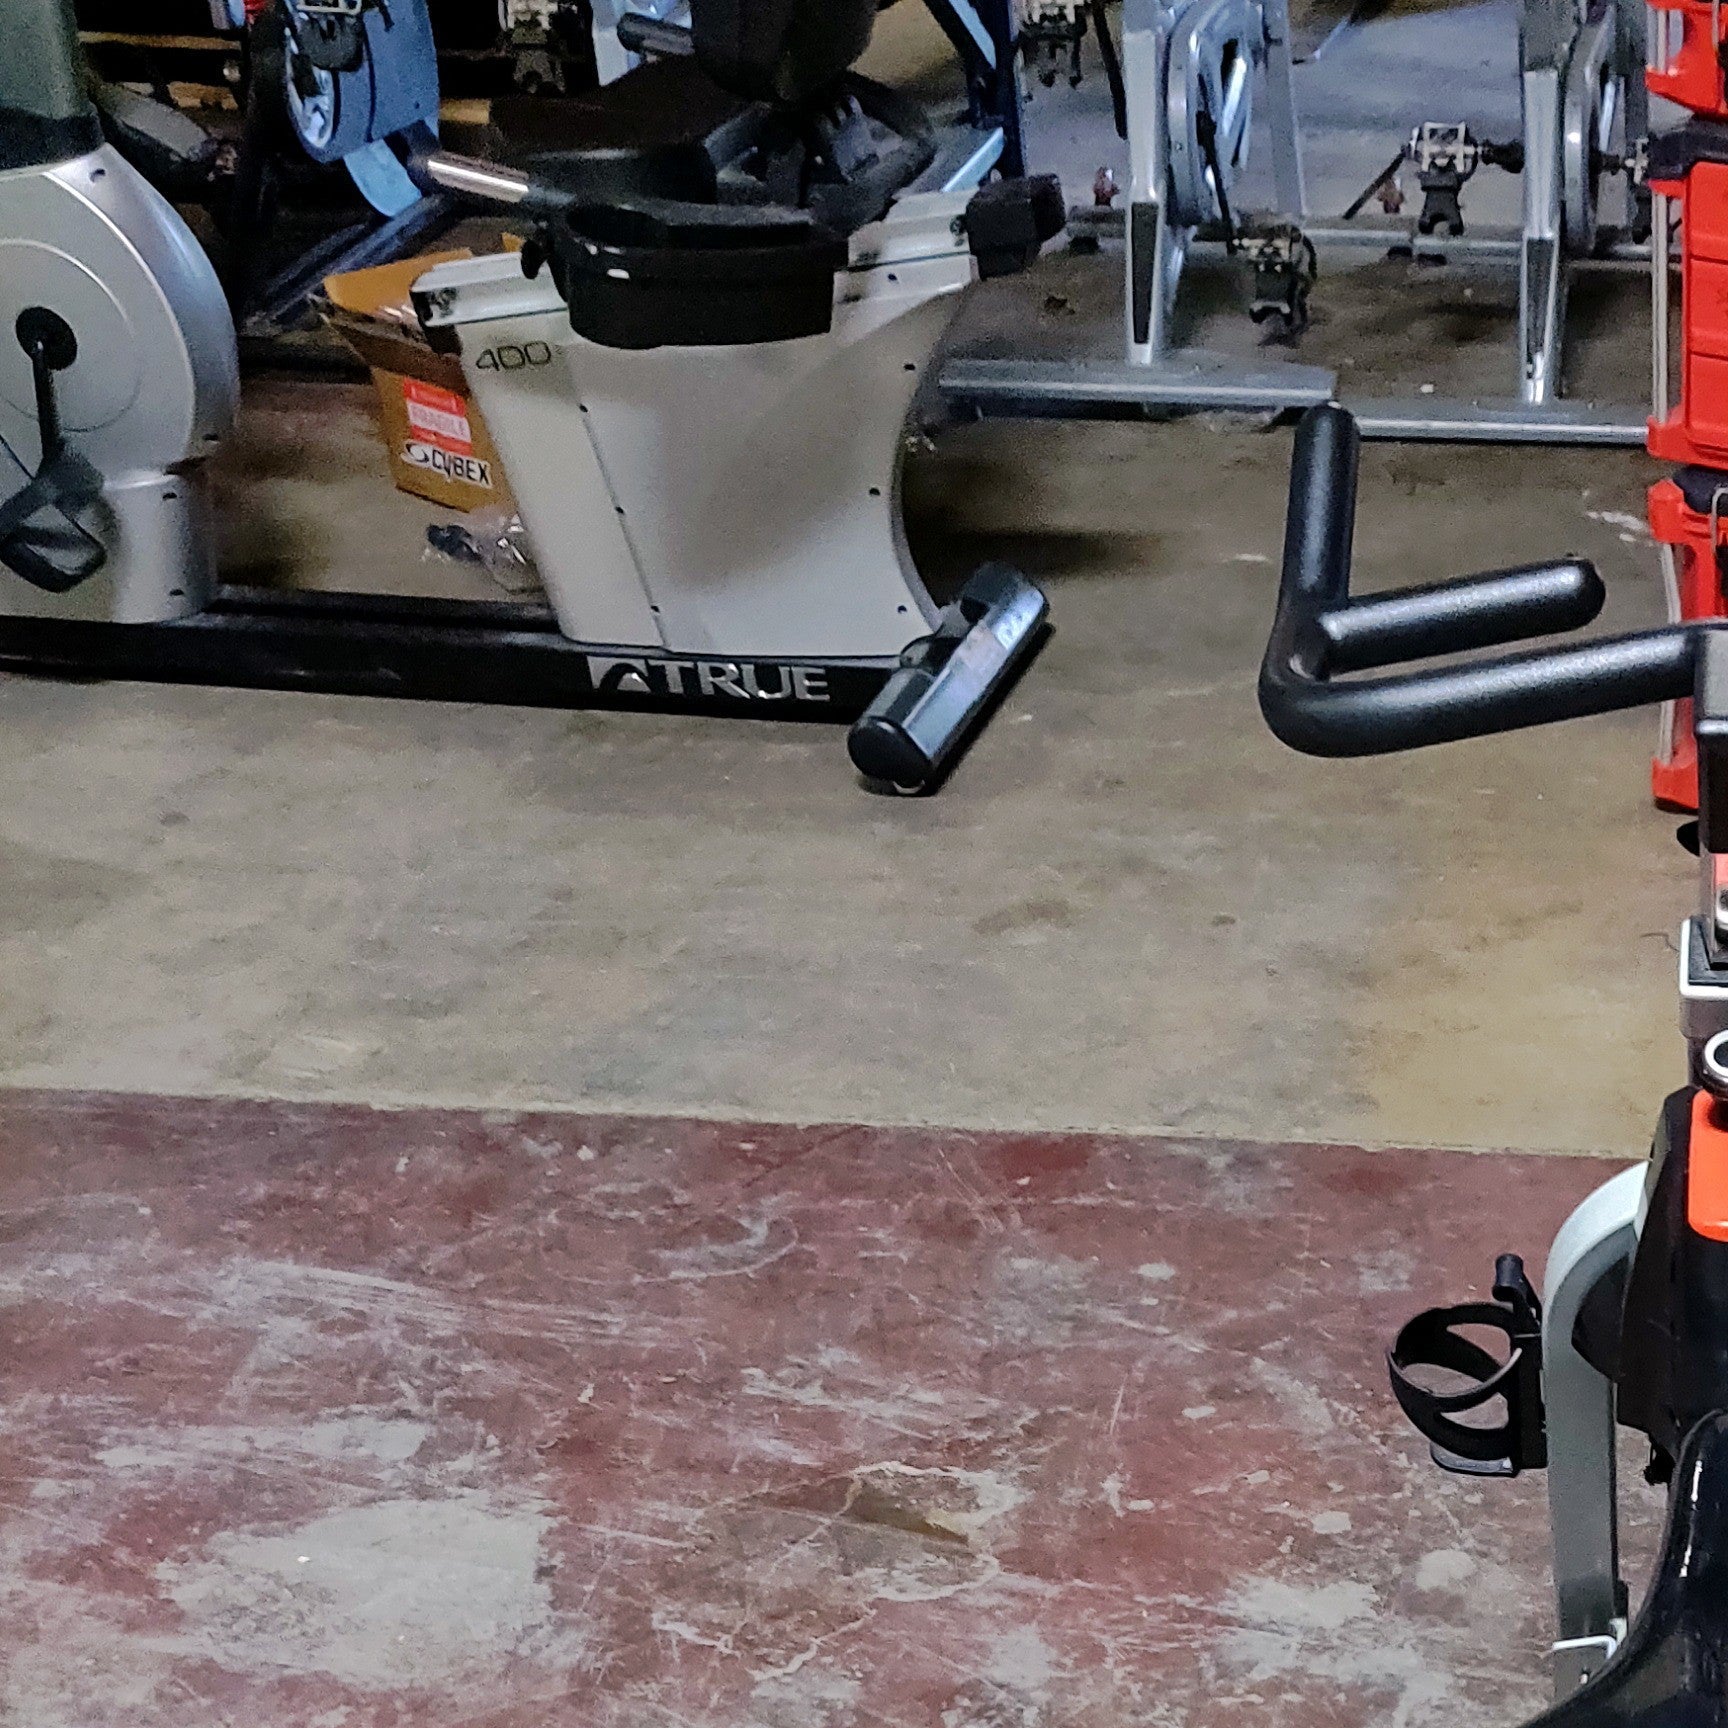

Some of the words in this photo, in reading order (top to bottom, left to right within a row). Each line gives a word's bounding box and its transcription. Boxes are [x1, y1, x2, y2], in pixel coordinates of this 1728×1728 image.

[476, 341, 551, 371] 400
[432, 448, 490, 486] CYBEX
[648, 658, 831, 701] TRUE
